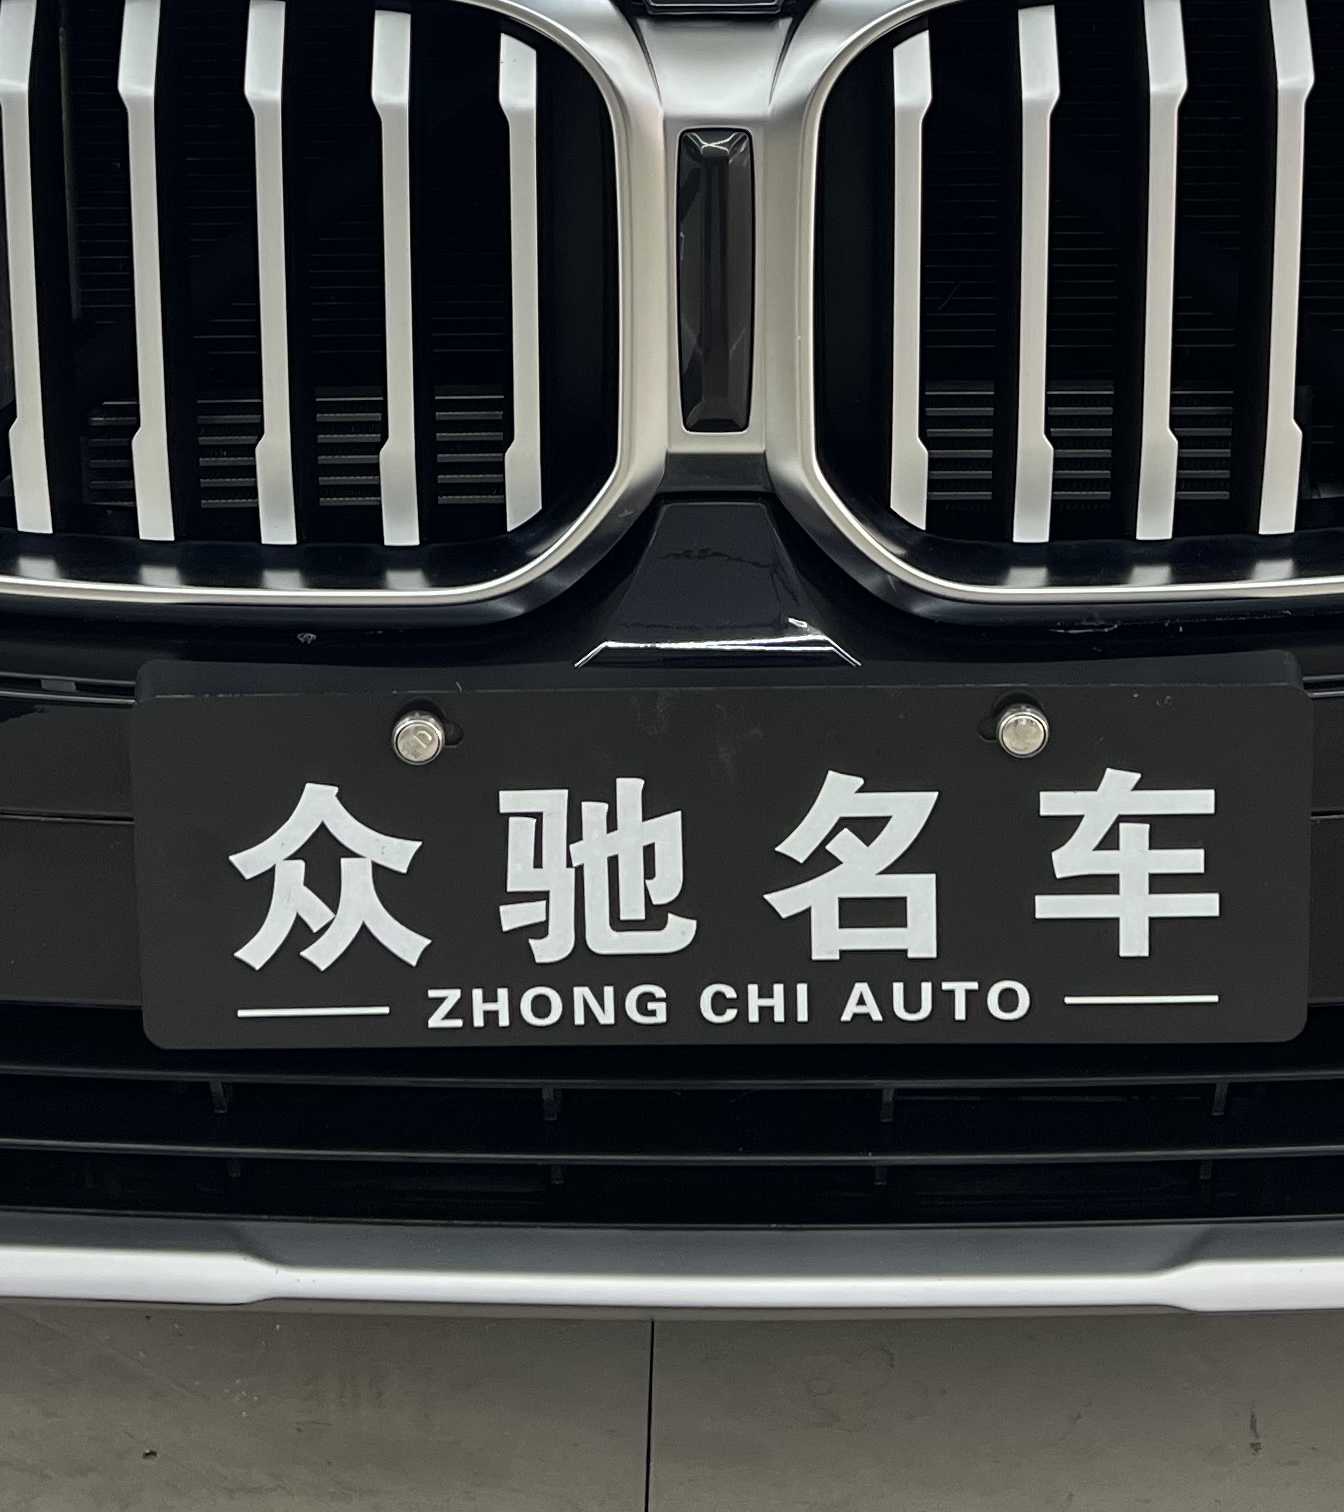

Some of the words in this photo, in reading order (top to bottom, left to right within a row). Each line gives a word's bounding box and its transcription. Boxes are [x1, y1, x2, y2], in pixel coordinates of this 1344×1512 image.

[229, 768, 1219, 971] 众驰名车
[428, 985, 669, 1029] ZHONG
[700, 983, 809, 1024] CHI
[840, 980, 1030, 1022] AUTO
